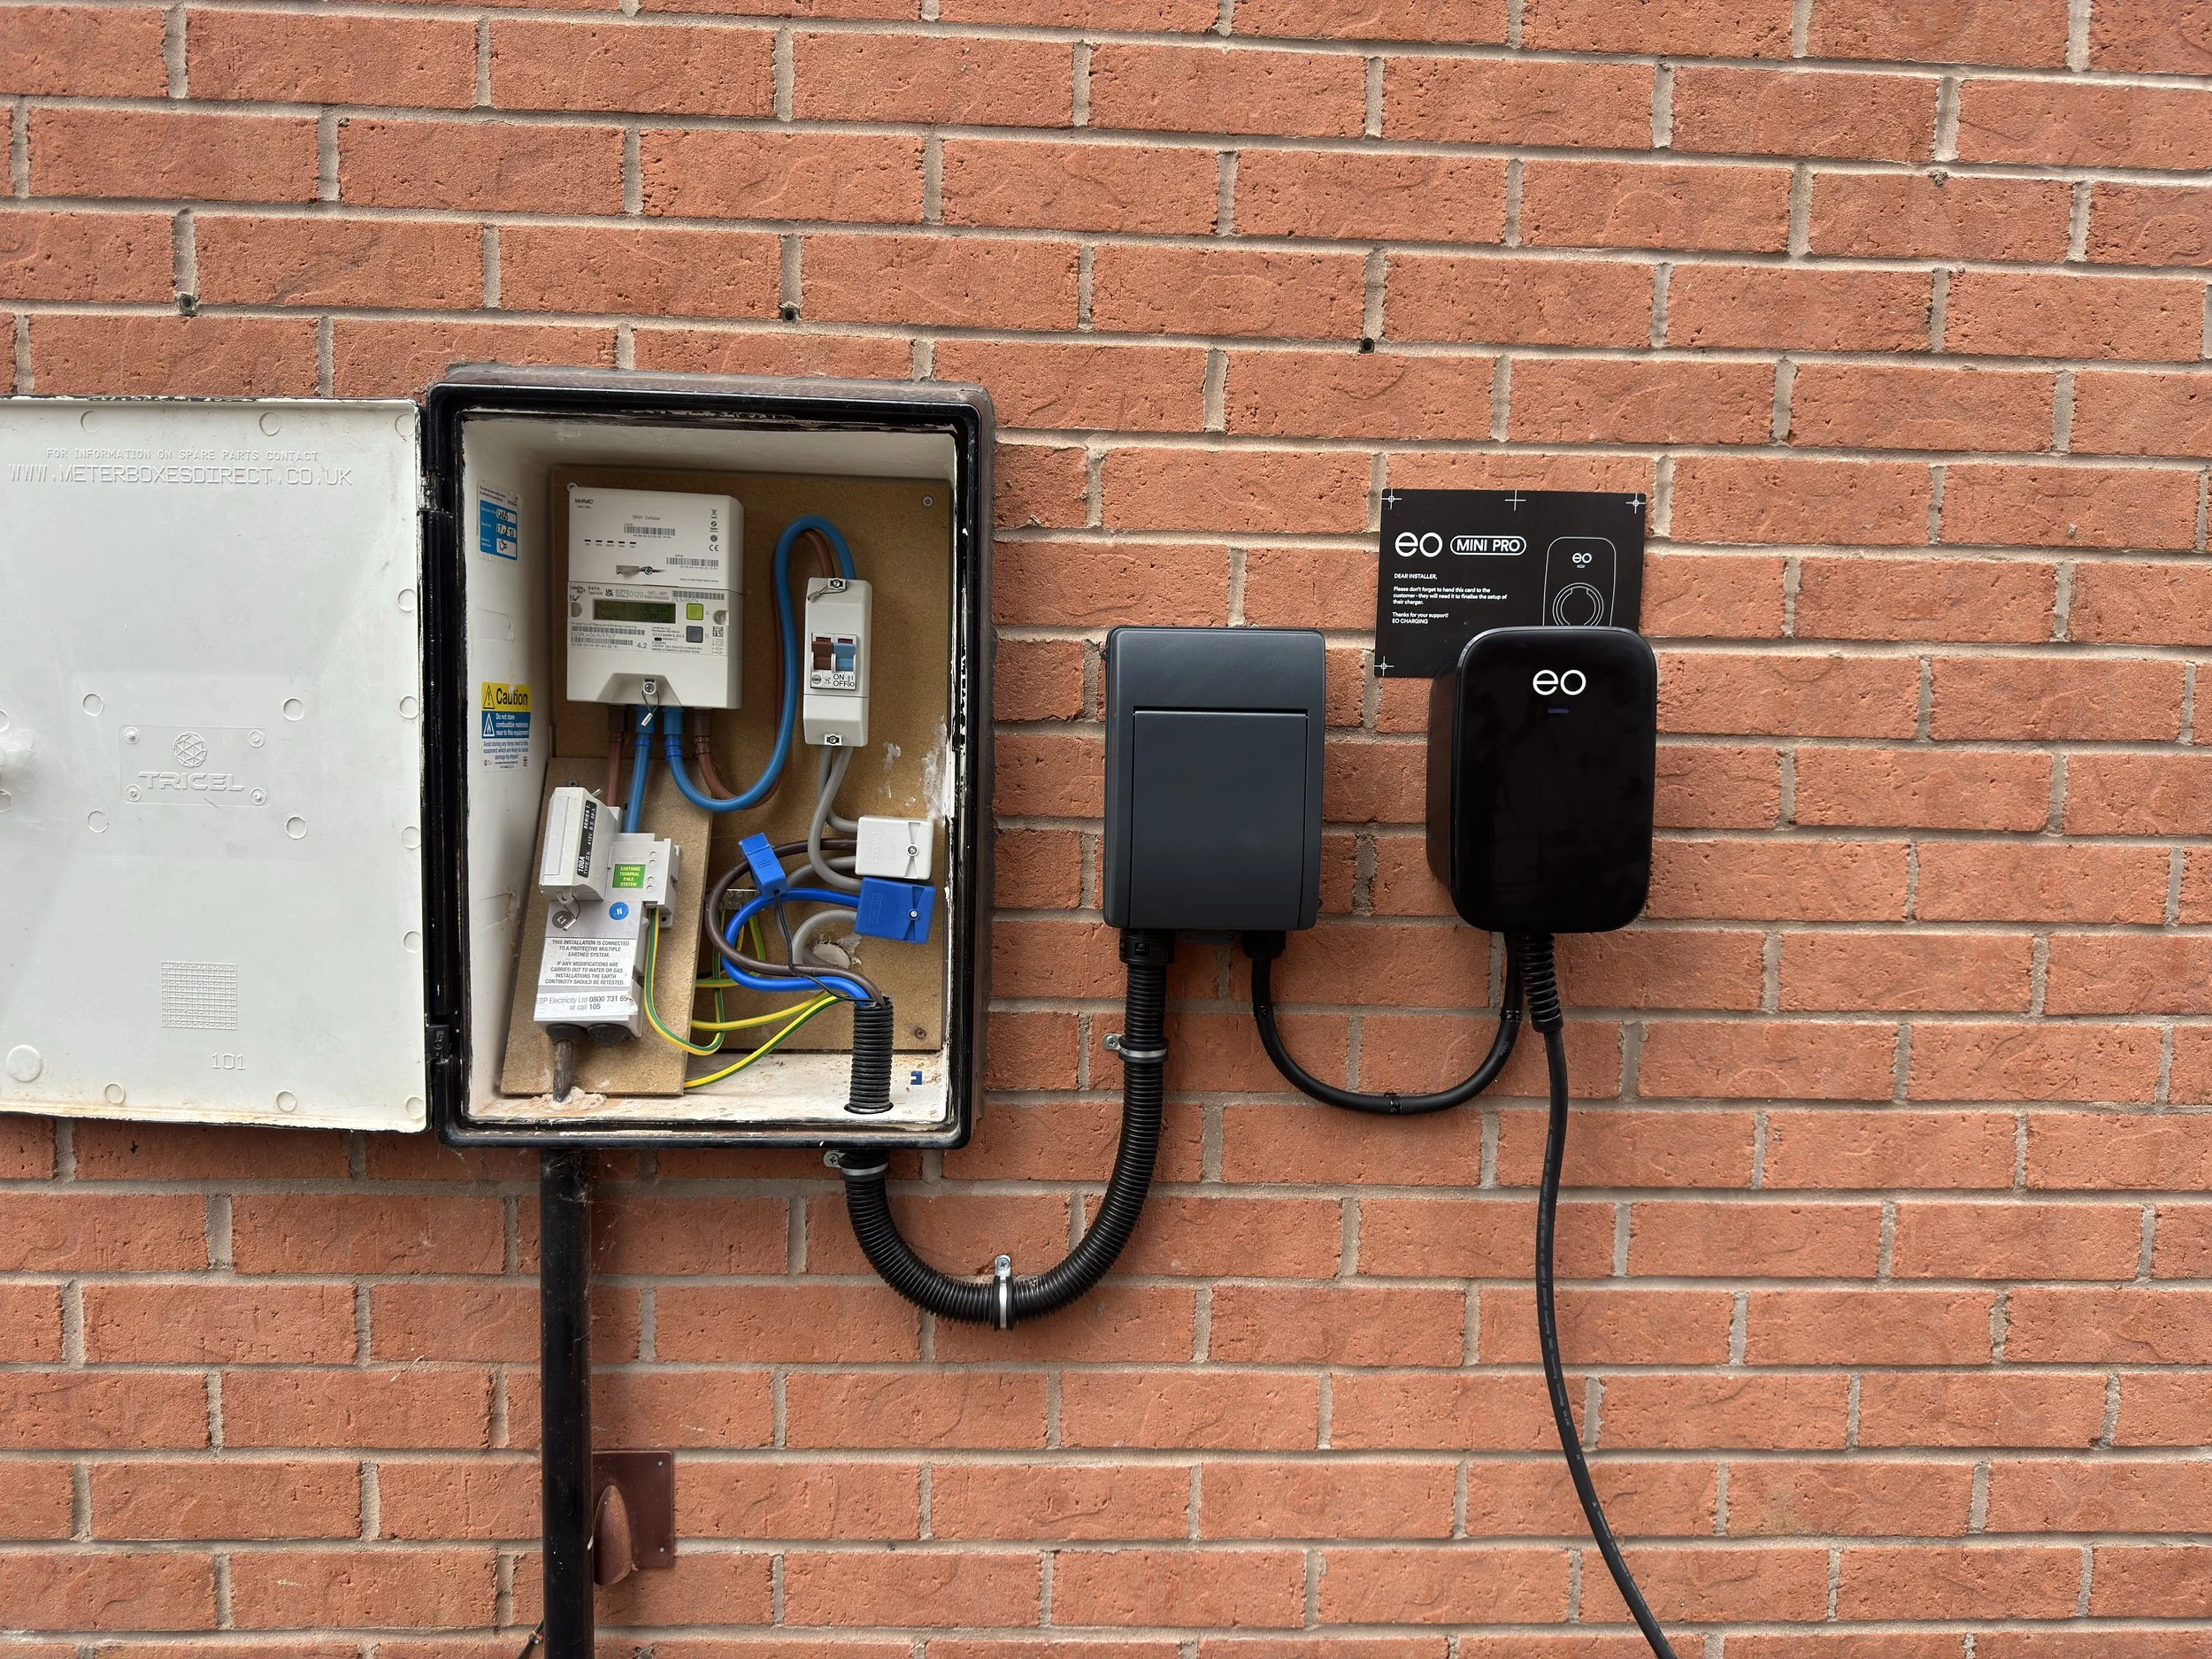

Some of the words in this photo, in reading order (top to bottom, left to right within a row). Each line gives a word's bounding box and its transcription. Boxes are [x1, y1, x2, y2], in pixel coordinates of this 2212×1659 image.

[46, 448, 68, 458] FOR
[74, 448, 151, 459] INFORMATION
[157, 449, 173, 459] ON
[179, 449, 215, 460] SPARE
[222, 449, 259, 461] PARTS
[265, 450, 319, 462] CONTACT
[8, 463, 353, 486] WWW.METERBOXESDIRECT.CO.UK
[1394, 532, 1443, 557] eo
[1456, 539, 1487, 552] MINI
[1492, 539, 1521, 552] PRO
[1571, 552, 1593, 564] eo
[1532, 669, 1586, 695] eo
[496, 687, 528, 705] Caution
[138, 771, 244, 792] TRICEL
[212, 1052, 246, 1070] 101
